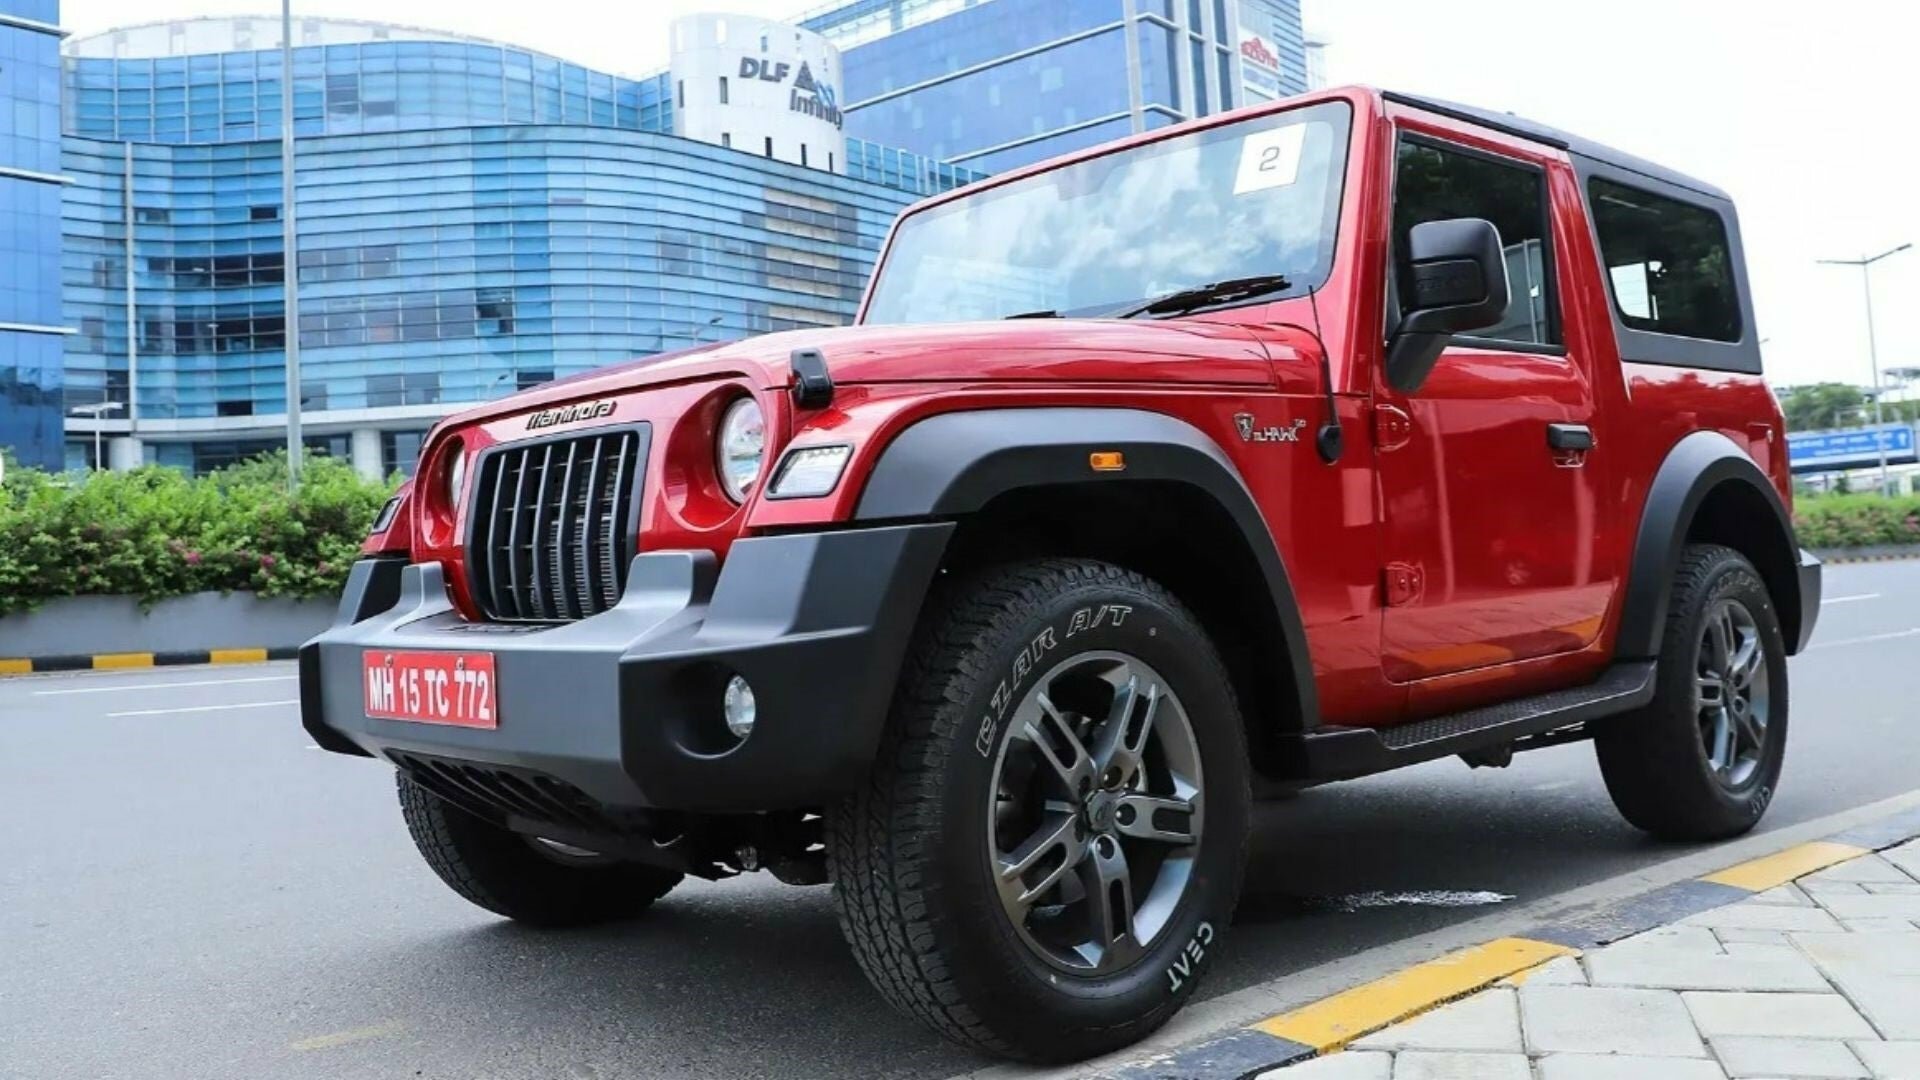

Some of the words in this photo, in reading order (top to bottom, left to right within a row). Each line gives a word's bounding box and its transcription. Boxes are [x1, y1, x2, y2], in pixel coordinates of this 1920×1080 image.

[738, 56, 790, 83] DLF
[790, 88, 843, 130] Infinity
[1259, 146, 1280, 172] 2
[368, 667, 395, 712] MH
[400, 668, 420, 715] 15
[424, 668, 449, 717] TC
[454, 669, 490, 721] 772
[975, 626, 1058, 758] CZAR
[1065, 605, 1132, 638] A/T
[1166, 922, 1214, 993] CEAT
